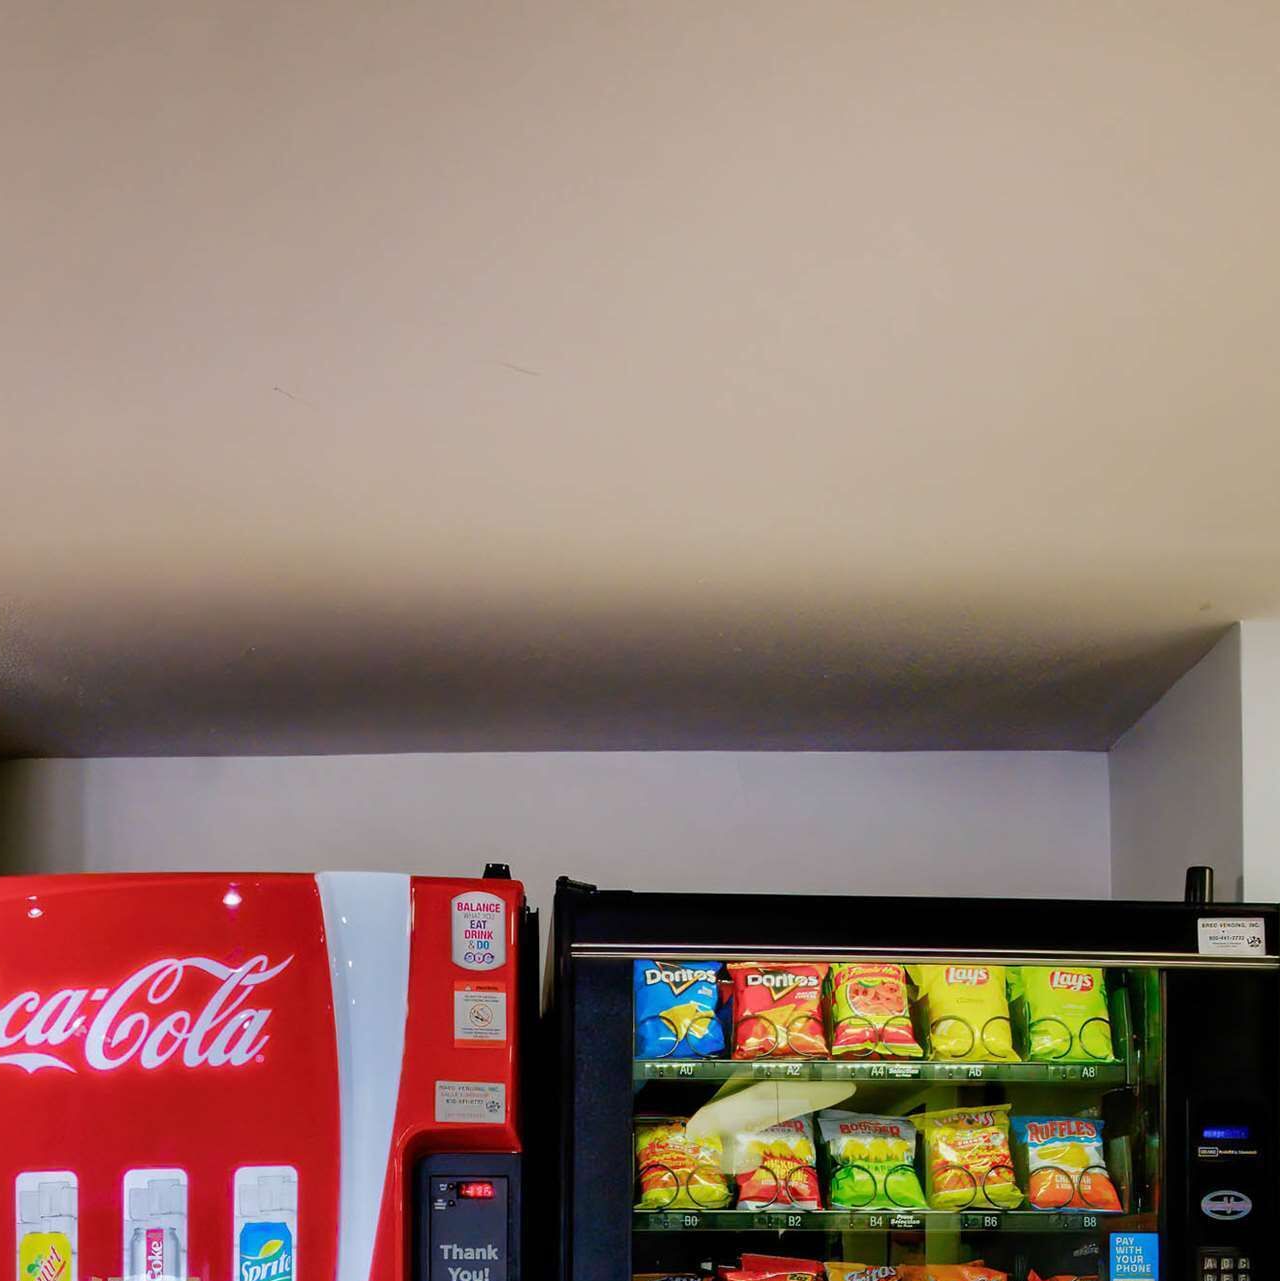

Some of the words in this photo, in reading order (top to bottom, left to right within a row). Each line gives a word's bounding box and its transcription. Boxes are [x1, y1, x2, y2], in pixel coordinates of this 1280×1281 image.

[457, 902, 501, 913] BALANCE
[470, 920, 487, 929] EAT
[464, 931, 494, 940] DRINK
[468, 942, 475, 950] &
[477, 941, 490, 950] DO
[645, 969, 717, 985] Doritos
[747, 973, 819, 988] Doritos
[680, 1065, 693, 1075] A0
[787, 1065, 800, 1075] A2
[871, 1067, 884, 1076] A4
[968, 1068, 981, 1077] A6
[1082, 1067, 1095, 1077] A8
[1027, 1120, 1096, 1142] RUFFLES
[788, 1216, 801, 1226] B2
[870, 1216, 882, 1226] B4
[984, 1216, 997, 1226] B6
[1083, 1216, 1096, 1227] B8
[1116, 1237, 1134, 1245] PAY
[440, 1244, 498, 1260] Thank
[1116, 1246, 1143, 1254] WITH
[1116, 1255, 1144, 1264] YOUR
[1116, 1264, 1151, 1273] PHONE
